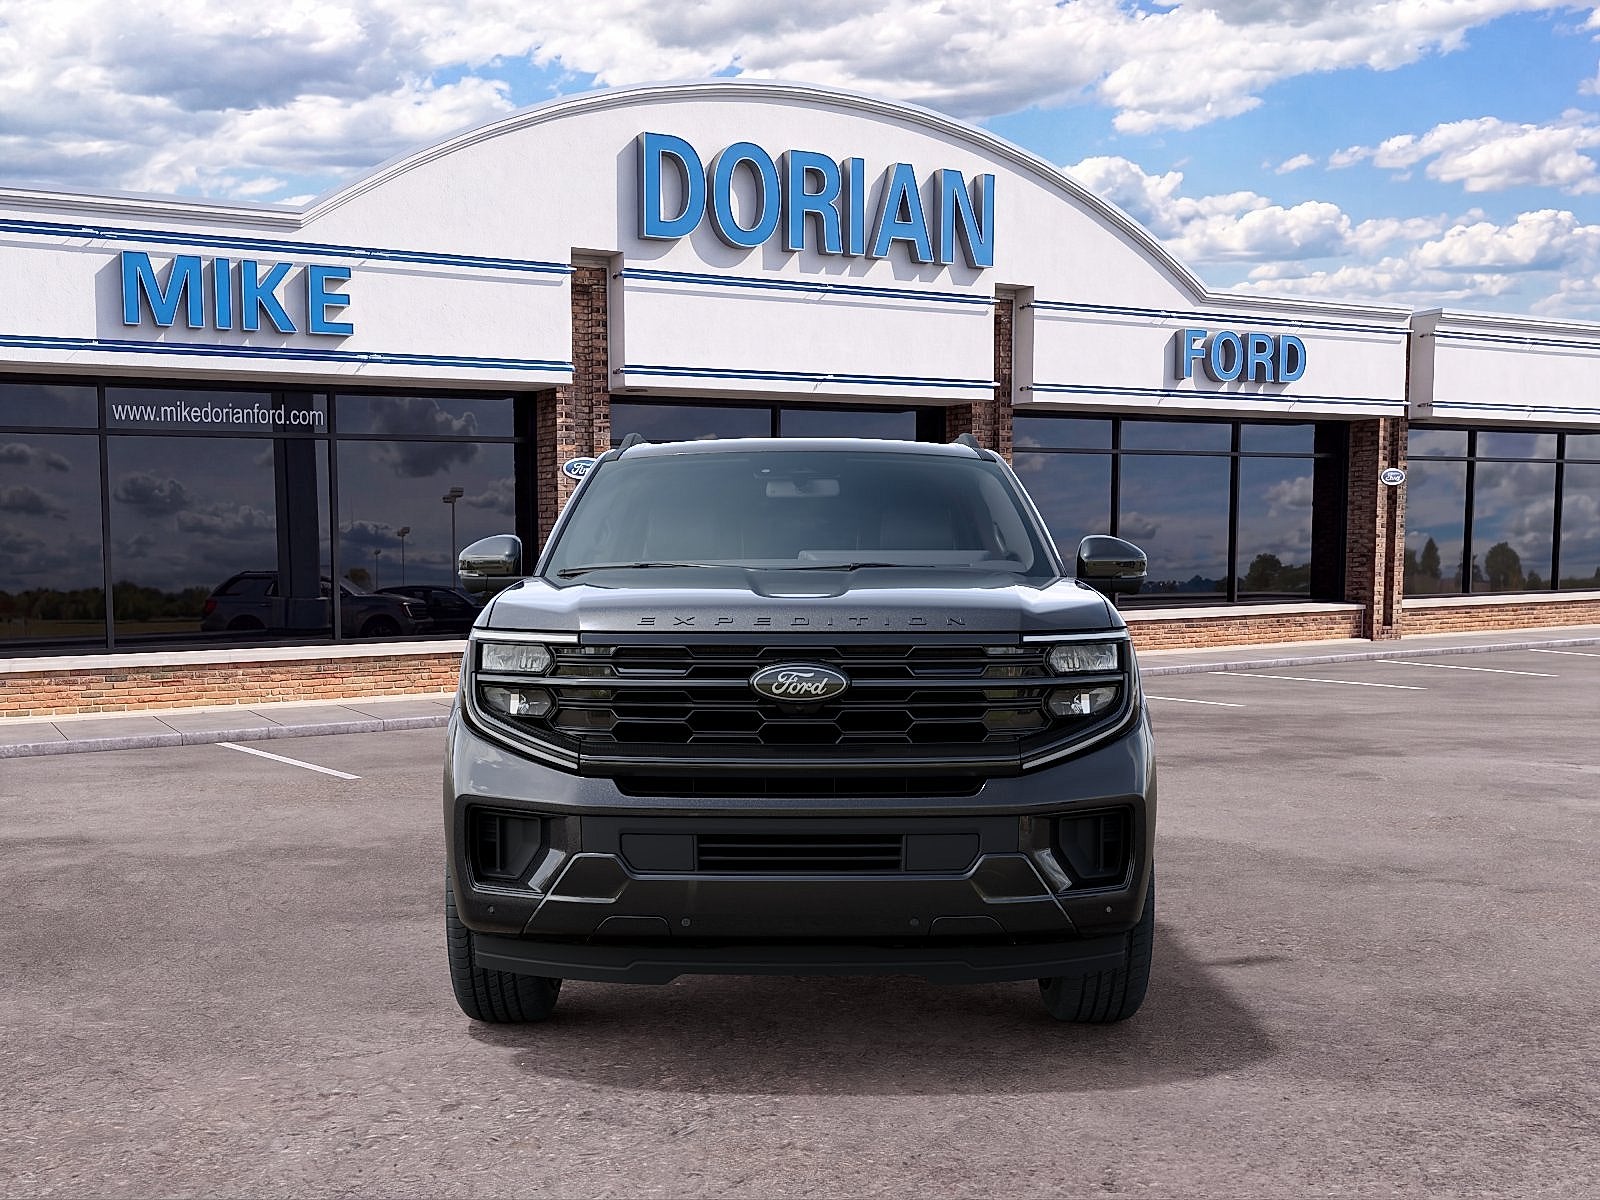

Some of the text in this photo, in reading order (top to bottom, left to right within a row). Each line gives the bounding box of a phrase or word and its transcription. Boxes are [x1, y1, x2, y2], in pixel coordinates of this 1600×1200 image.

[638, 131, 995, 269] DORIAN
[121, 250, 353, 336] MIKE
[1175, 328, 1307, 383] FORD
[112, 401, 324, 426] www.mikedorianford.com
[637, 617, 966, 626] EXPEDITION
[771, 671, 829, 695] Ford
